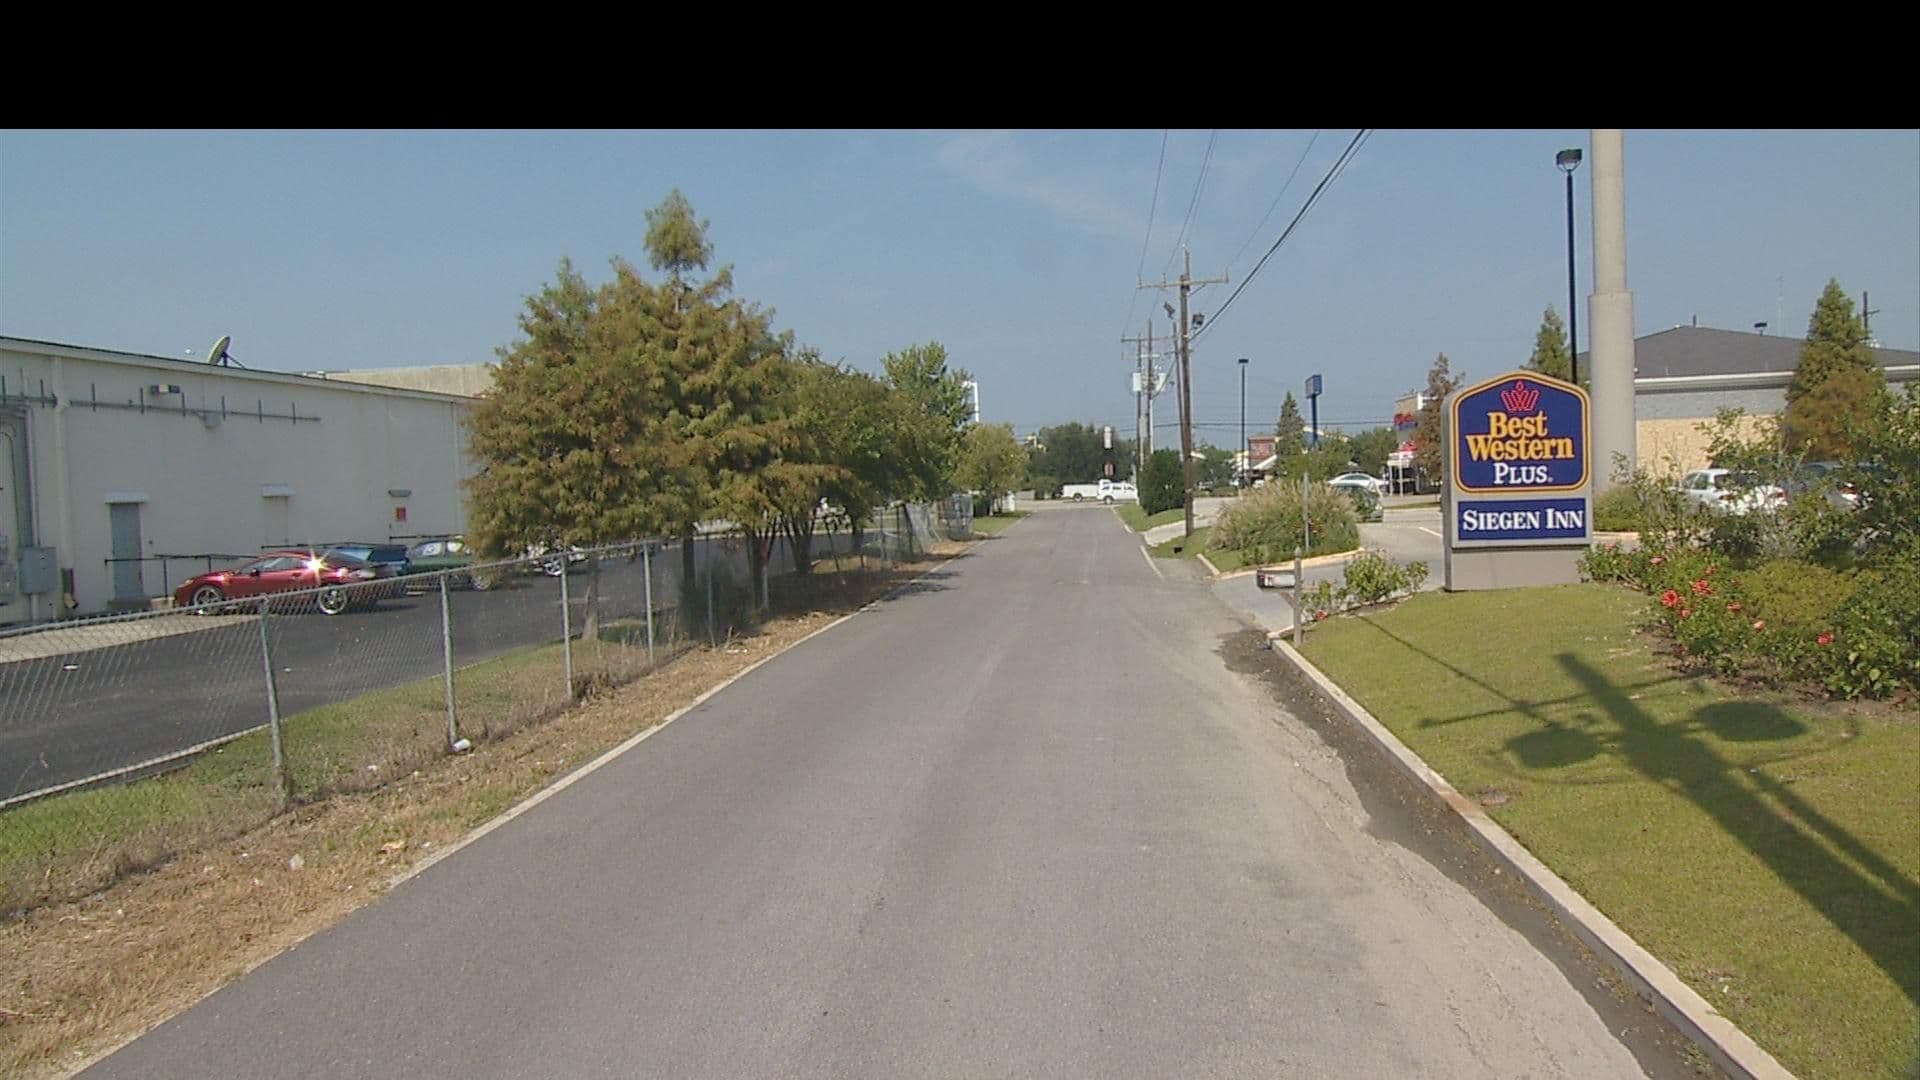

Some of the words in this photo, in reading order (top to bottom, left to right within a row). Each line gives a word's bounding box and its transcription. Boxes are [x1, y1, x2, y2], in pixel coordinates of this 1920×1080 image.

[1487, 410, 1548, 438] Best
[1465, 432, 1575, 462] Western
[1463, 509, 1540, 531] SIEGEN
[1546, 507, 1584, 529] INN
